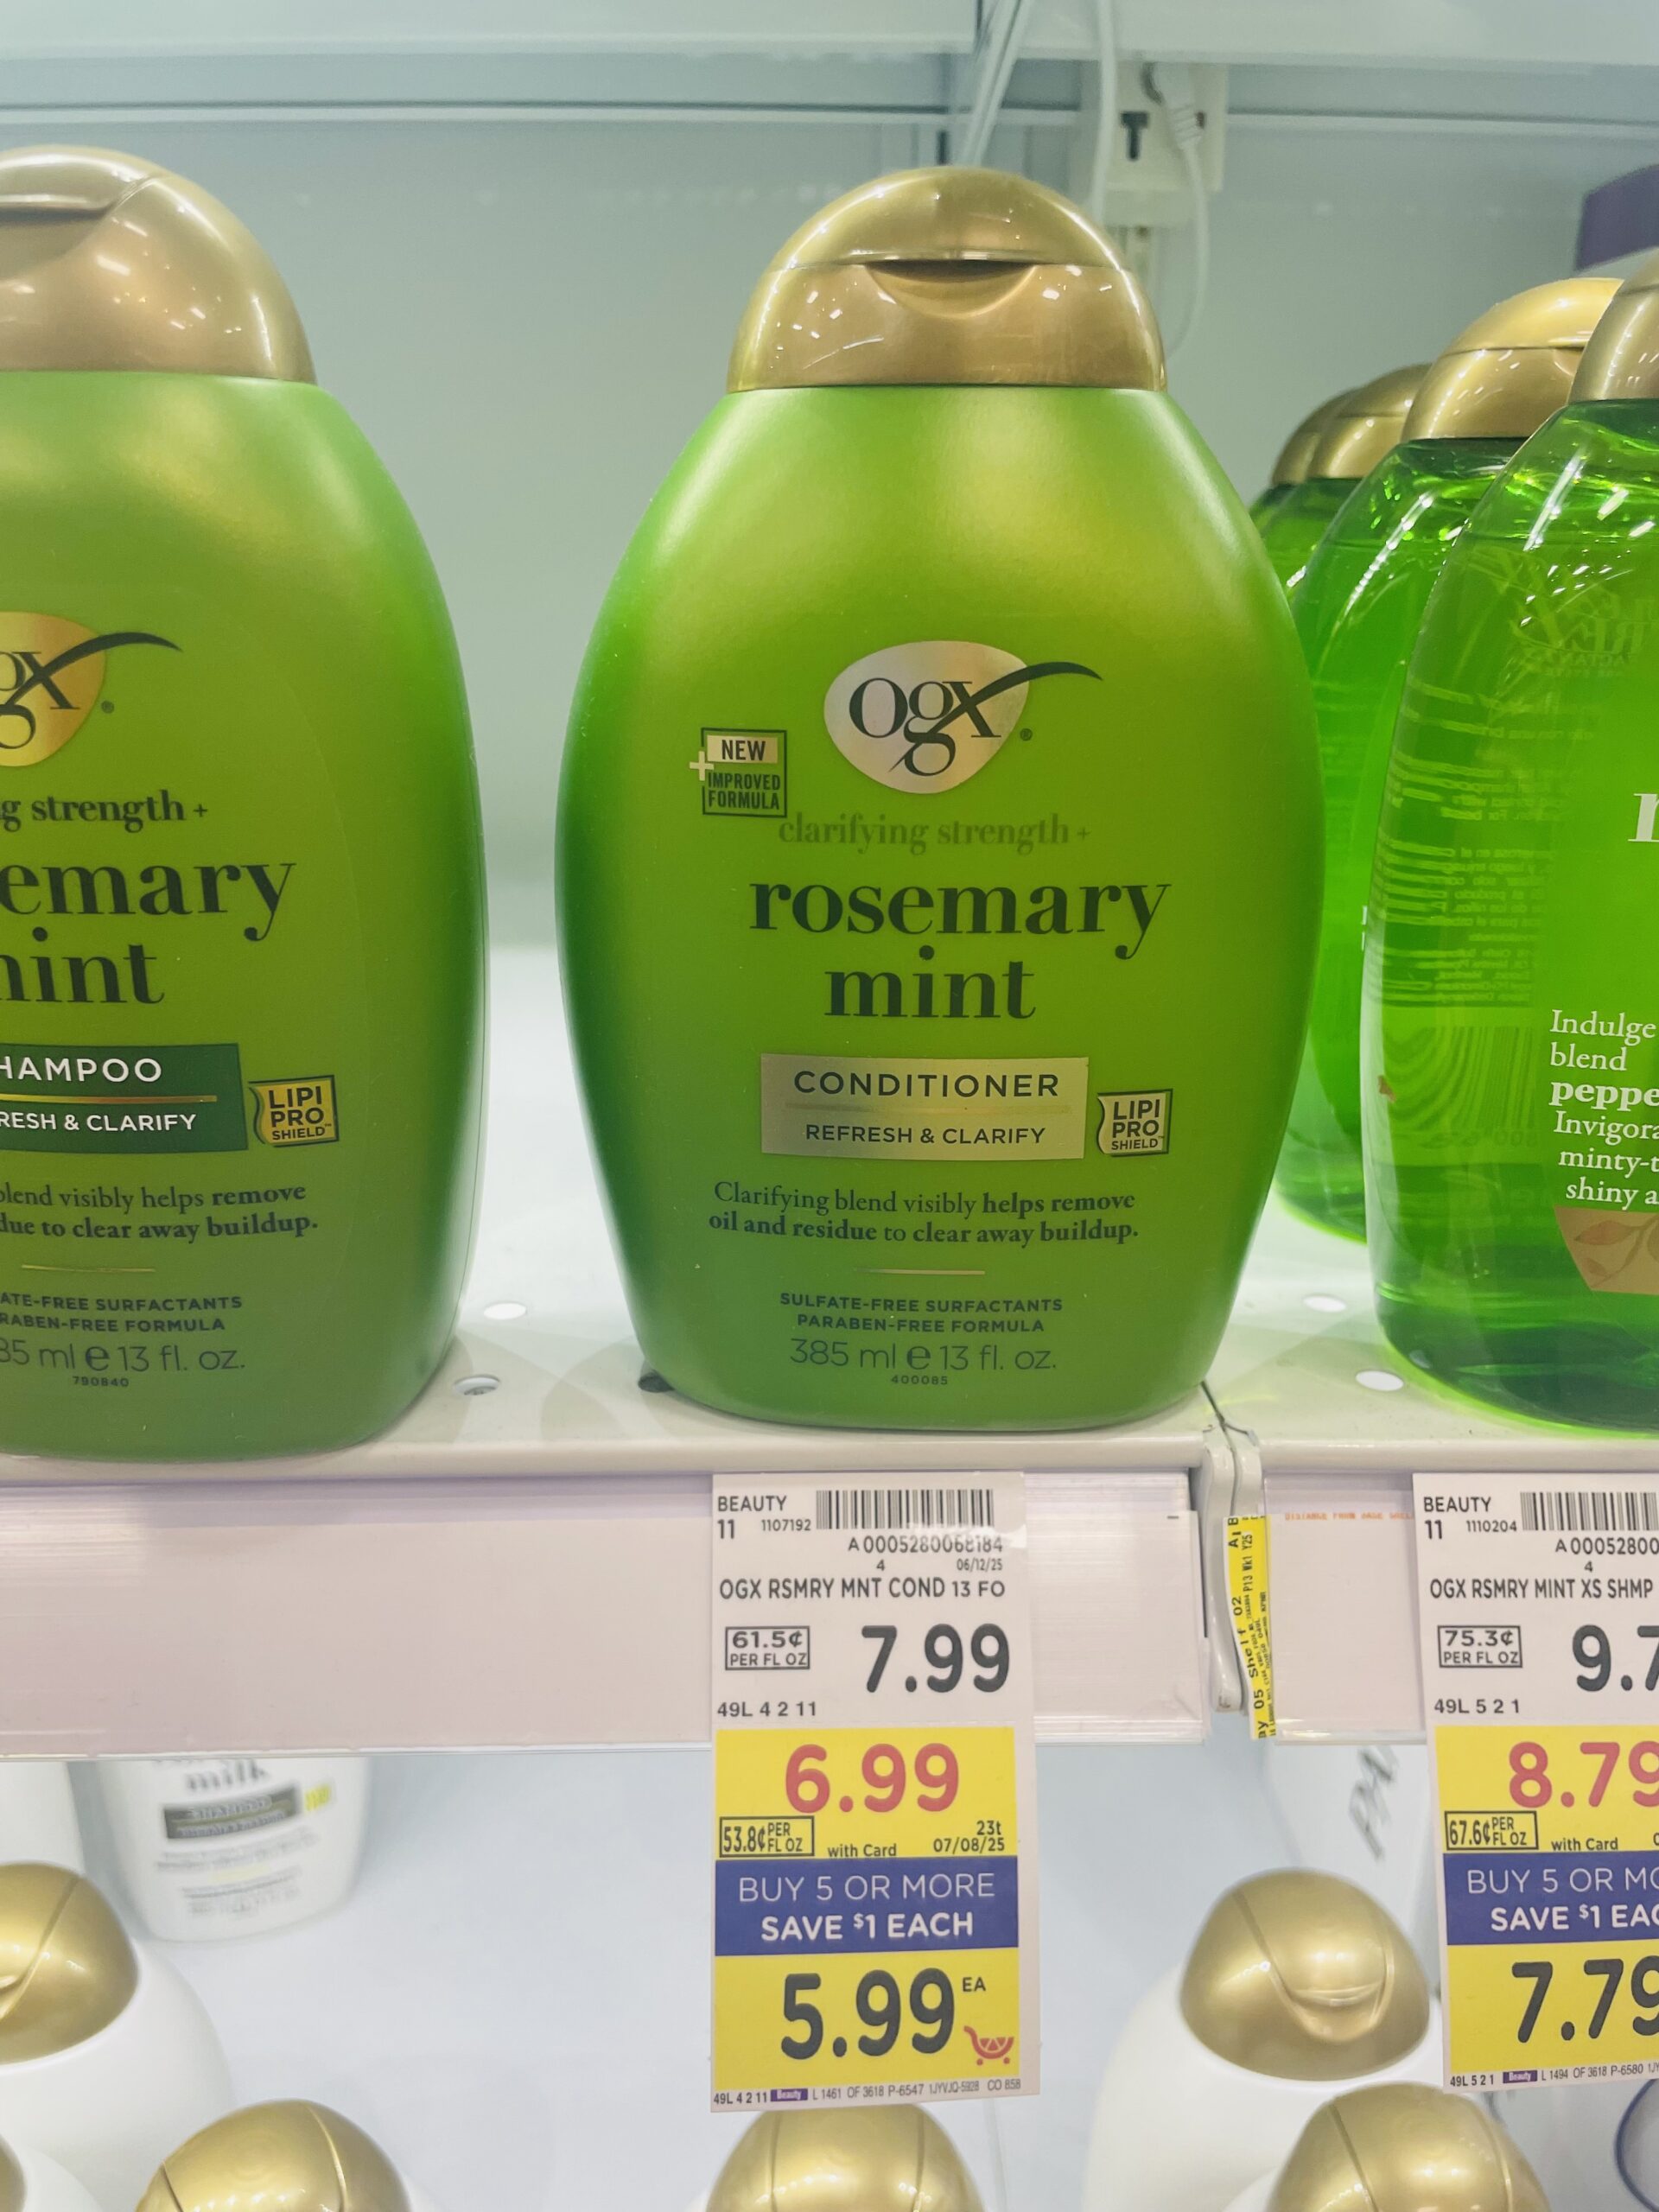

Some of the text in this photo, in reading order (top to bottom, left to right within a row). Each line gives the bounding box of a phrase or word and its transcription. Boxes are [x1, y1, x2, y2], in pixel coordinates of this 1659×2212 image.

[721, 739, 766, 761] NEW
[707, 771, 781, 791] IMPROVED
[708, 790, 780, 811] FORMULA
[32, 790, 187, 834] strength
[779, 812, 1069, 855] clarifying strength
[749, 882, 1173, 960] rosemary
[823, 944, 1036, 1019] mint
[1549, 1008, 1657, 1046] Indulge
[1550, 1041, 1627, 1071] blend
[793, 1071, 1060, 1097] CONDITIONER
[268, 1085, 322, 1109] LIPI
[270, 1107, 326, 1128] PRO
[1112, 1098, 1161, 1121] LIPI
[65, 1115, 79, 1131] &
[86, 1113, 198, 1132] CLARIFY
[1111, 1118, 1160, 1139] PRO
[805, 1124, 1046, 1145] REFRESH & CLARIFY
[59, 1185, 307, 1214] visibly helps remove
[714, 1180, 1135, 1221] Clarifying blend visibly helps remove
[1566, 1176, 1639, 1211] shiny
[41, 1211, 319, 1244] to clear away buildup.
[708, 1211, 1139, 1249] oil and residue to clear away buildup.
[96, 1296, 243, 1313] SURFACTANTS
[780, 1292, 1063, 1313] SULFATE-FREE SURFACTANTS
[125, 1318, 226, 1333] FORMULA
[798, 1313, 1046, 1333] PARABEN-FREE FORMULA
[40, 1344, 245, 1372] ml 13 fl. oz.
[790, 1338, 1057, 1371] 385 ml 13 fl. oz.
[716, 1495, 787, 1512] BEAUTY
[1423, 1496, 1491, 1513] BEAUTY
[716, 1518, 812, 1540] 11 1107192
[1424, 1519, 1517, 1540] 11 1110204
[1242, 1534, 1253, 1551] Y25
[956, 1558, 1003, 1573] 06/12/25
[720, 1577, 1006, 1599] OGX RSMRY MNT COND 13 FO
[1430, 1579, 1654, 1599] OGX RSMRY MINT XS SHMP
[1231, 1596, 1243, 1617] 02
[732, 1630, 804, 1649] 61.5¢
[1444, 1630, 1514, 1647] 75.3¢
[729, 1652, 808, 1666] PER FL OZ
[861, 1623, 1010, 1694] 7.99
[1239, 1628, 1259, 1679] Shelf
[1443, 1650, 1519, 1664] PER FL OZ
[716, 1701, 817, 1718] 49L 4 2 11
[1253, 1688, 1265, 1710] 05
[1434, 1699, 1520, 1713] 49L 5 2 1
[785, 1743, 960, 1814] 6.99
[767, 1822, 791, 1837] PER
[976, 1821, 1002, 1836] 23t
[1449, 1820, 1491, 1847] 67.6¢
[1492, 1817, 1515, 1831] PER
[722, 1826, 766, 1853] 53.8¢
[767, 1837, 804, 1853] FL OZ
[933, 1837, 1005, 1854] 07/08/25
[1492, 1832, 1527, 1846] FL OZ
[1551, 1837, 1619, 1852] with Card
[827, 1843, 897, 1858] with Card
[738, 1872, 995, 1902] BUY 5 OR MORE
[1466, 1866, 1614, 1895] BUY 5 OR
[760, 1911, 974, 1942] SAVE $1 EACH
[1491, 1904, 1601, 1931] SAVE $1
[962, 1977, 987, 1993] EA
[780, 1967, 956, 2061] 5.99
[1573, 2067, 1586, 2078] OF
[714, 2093, 734, 2105] 49L
[847, 2087, 862, 2099] OF
[862, 2085, 885, 2098] 3618
[888, 2083, 925, 2097] P-6547
